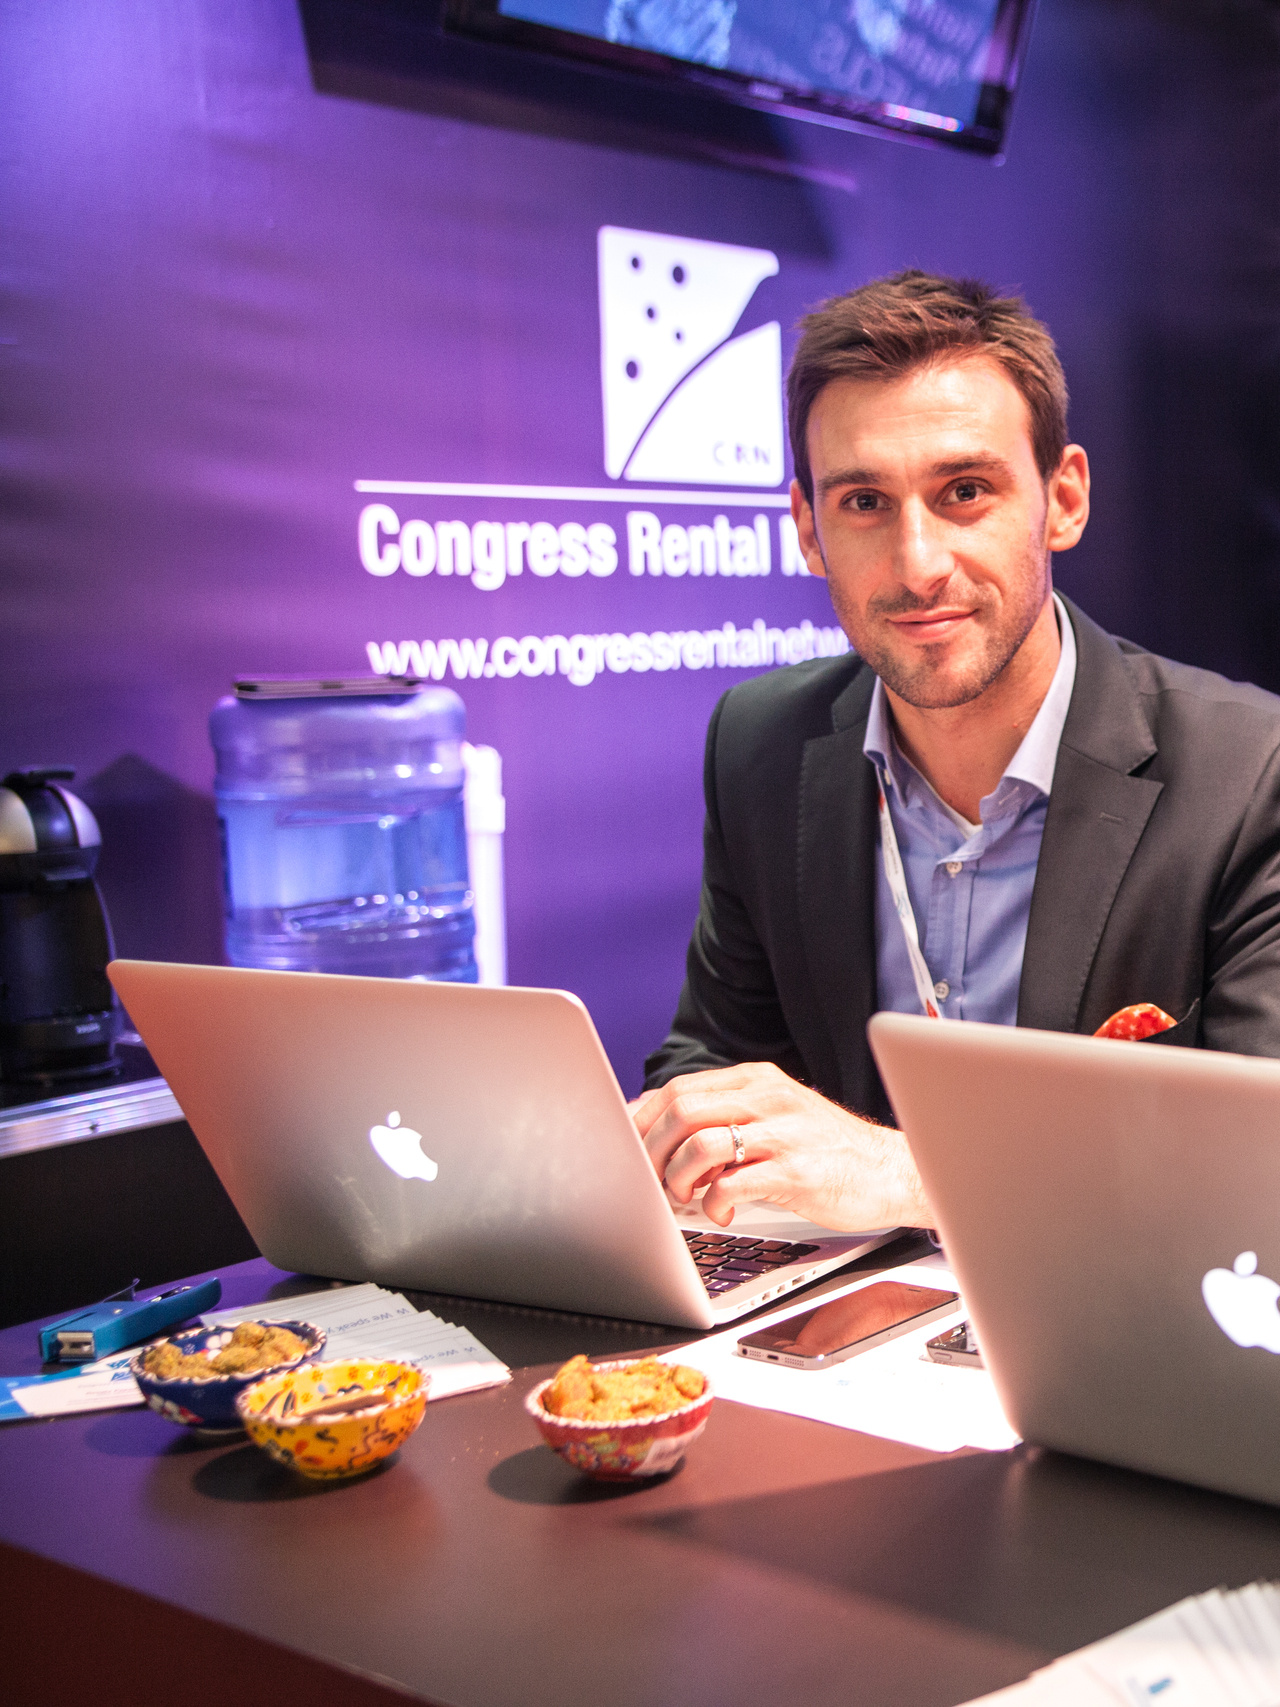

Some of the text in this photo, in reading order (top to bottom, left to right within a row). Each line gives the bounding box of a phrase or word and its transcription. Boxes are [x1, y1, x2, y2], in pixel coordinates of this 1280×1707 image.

[359, 503, 619, 591] Congress
[625, 511, 772, 577] Rental
[365, 617, 854, 687] www.congressrentalnetw
